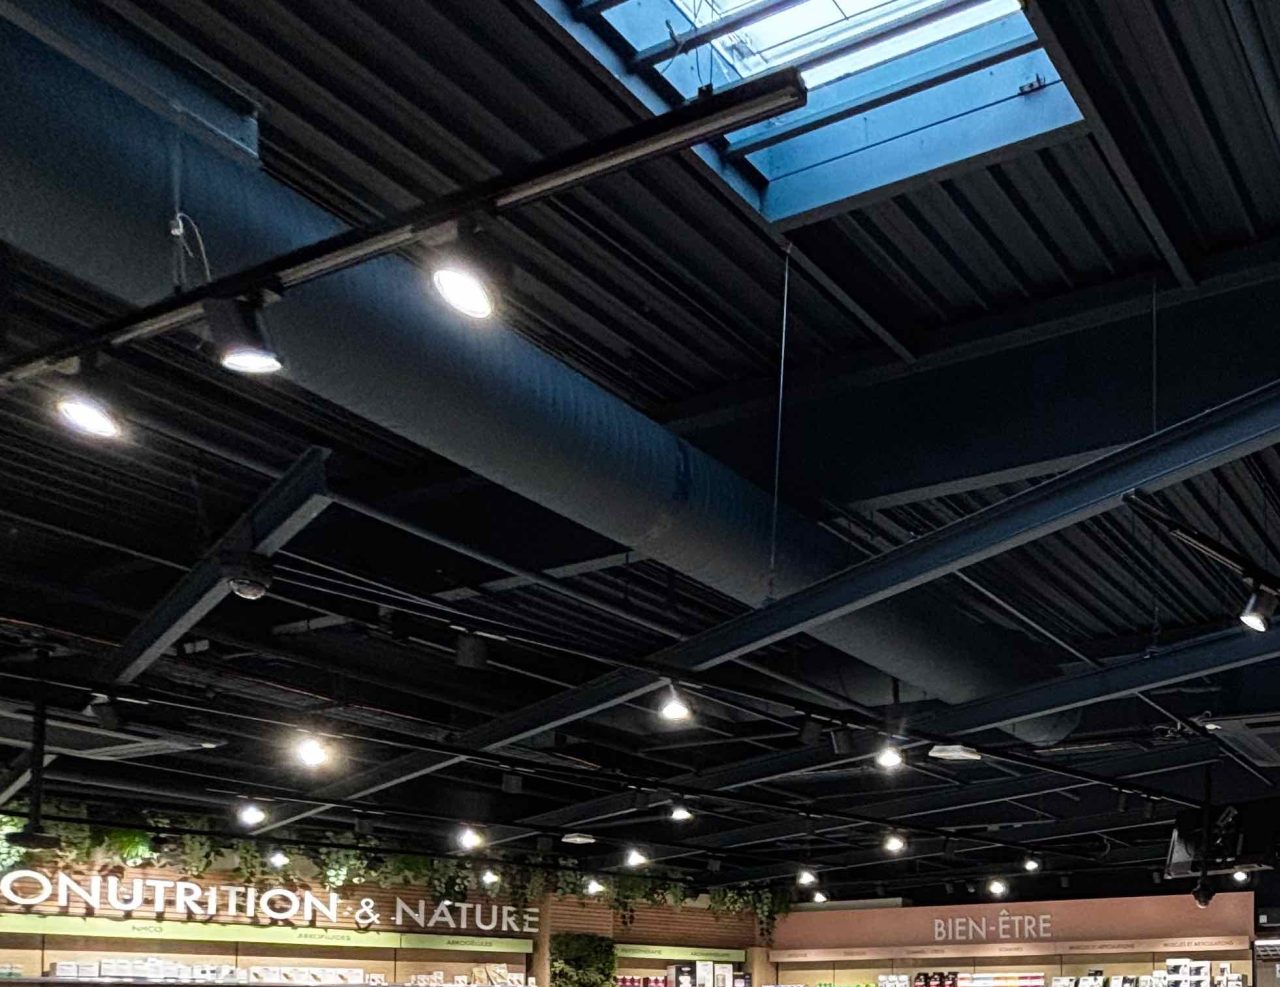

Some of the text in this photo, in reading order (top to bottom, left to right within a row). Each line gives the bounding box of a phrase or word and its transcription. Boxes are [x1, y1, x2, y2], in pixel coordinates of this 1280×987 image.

[0, 869, 539, 933] ONUTRITION & NATURE
[933, 909, 1052, 942] BIEN-ÊTRE
